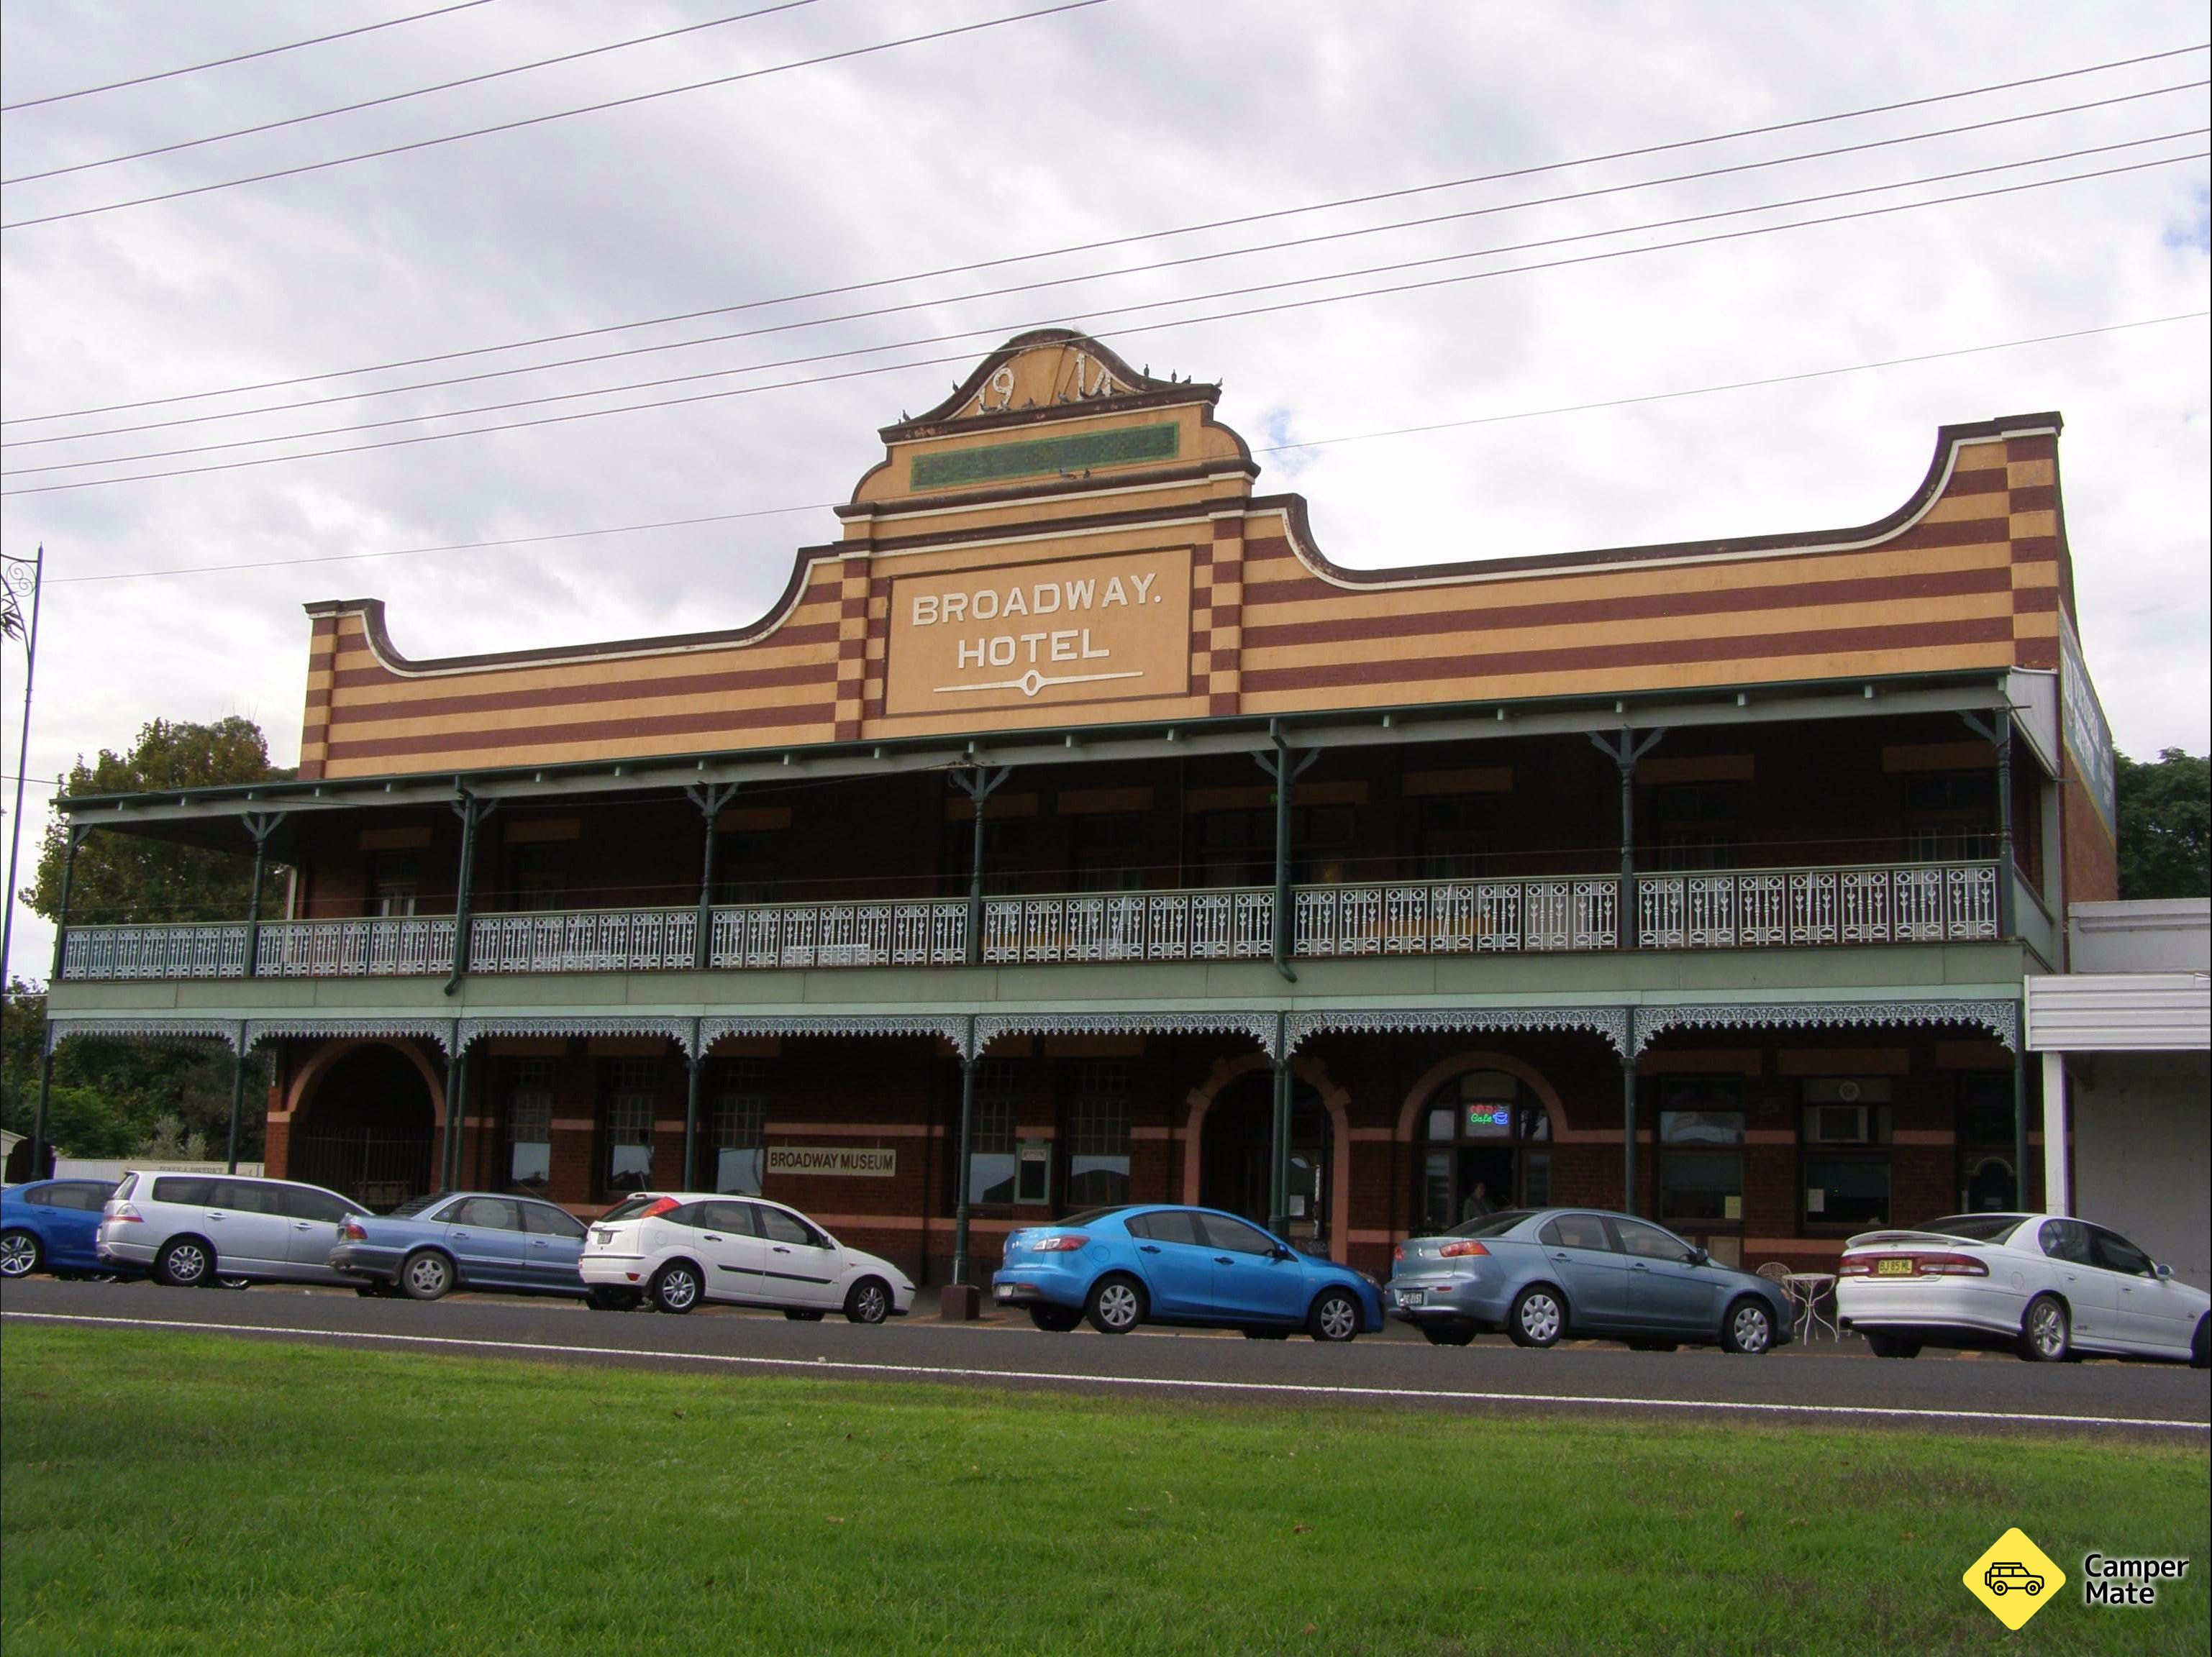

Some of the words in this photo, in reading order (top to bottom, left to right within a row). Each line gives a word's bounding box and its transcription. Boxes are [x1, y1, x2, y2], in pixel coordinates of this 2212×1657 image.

[957, 629, 1110, 669] HOTEL
[770, 1152, 839, 1169] BROADWAY
[840, 1154, 893, 1171] MUSEUM
